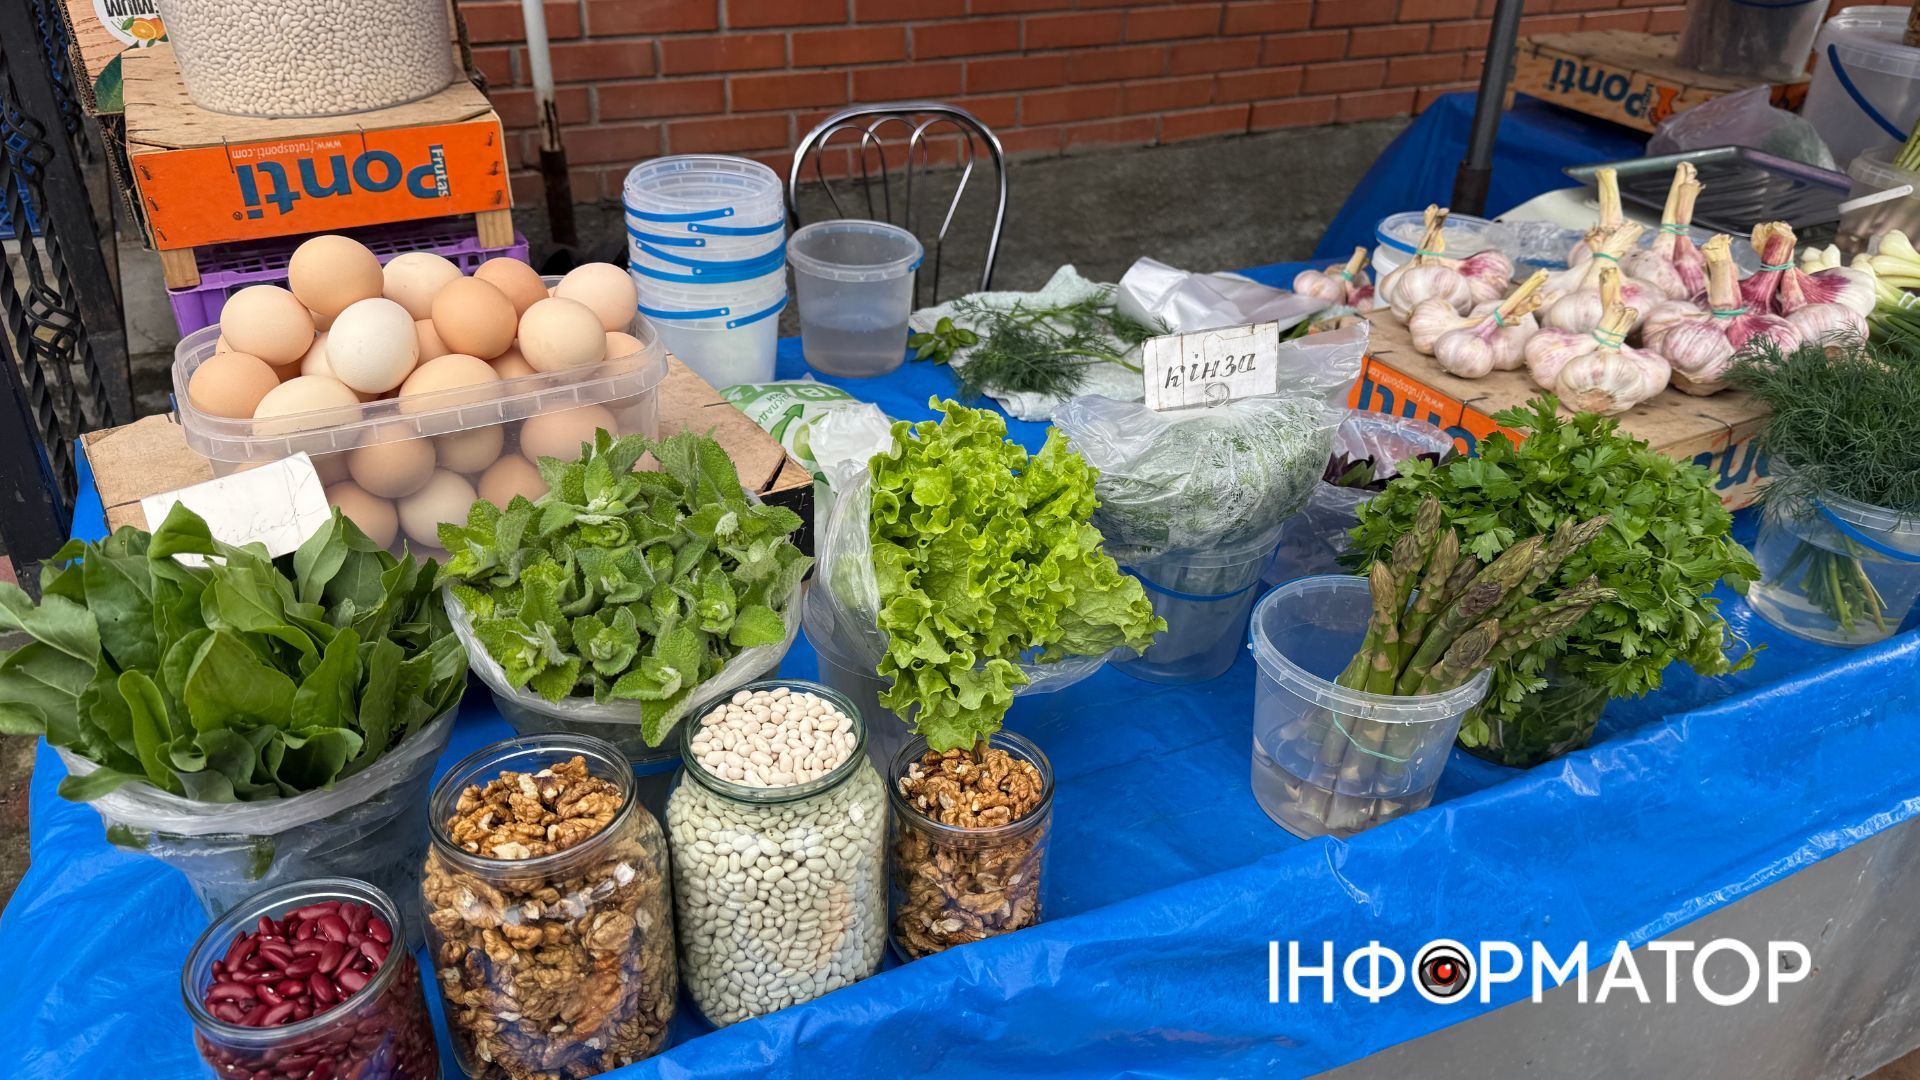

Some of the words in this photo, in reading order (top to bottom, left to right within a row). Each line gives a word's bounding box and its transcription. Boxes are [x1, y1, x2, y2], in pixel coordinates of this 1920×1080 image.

[104, 0, 159, 17] MIUM
[1547, 58, 1653, 118] Ponti
[232, 139, 342, 160] www.frutasponti.com
[431, 147, 449, 198] Frutas
[235, 147, 450, 220] Ponti
